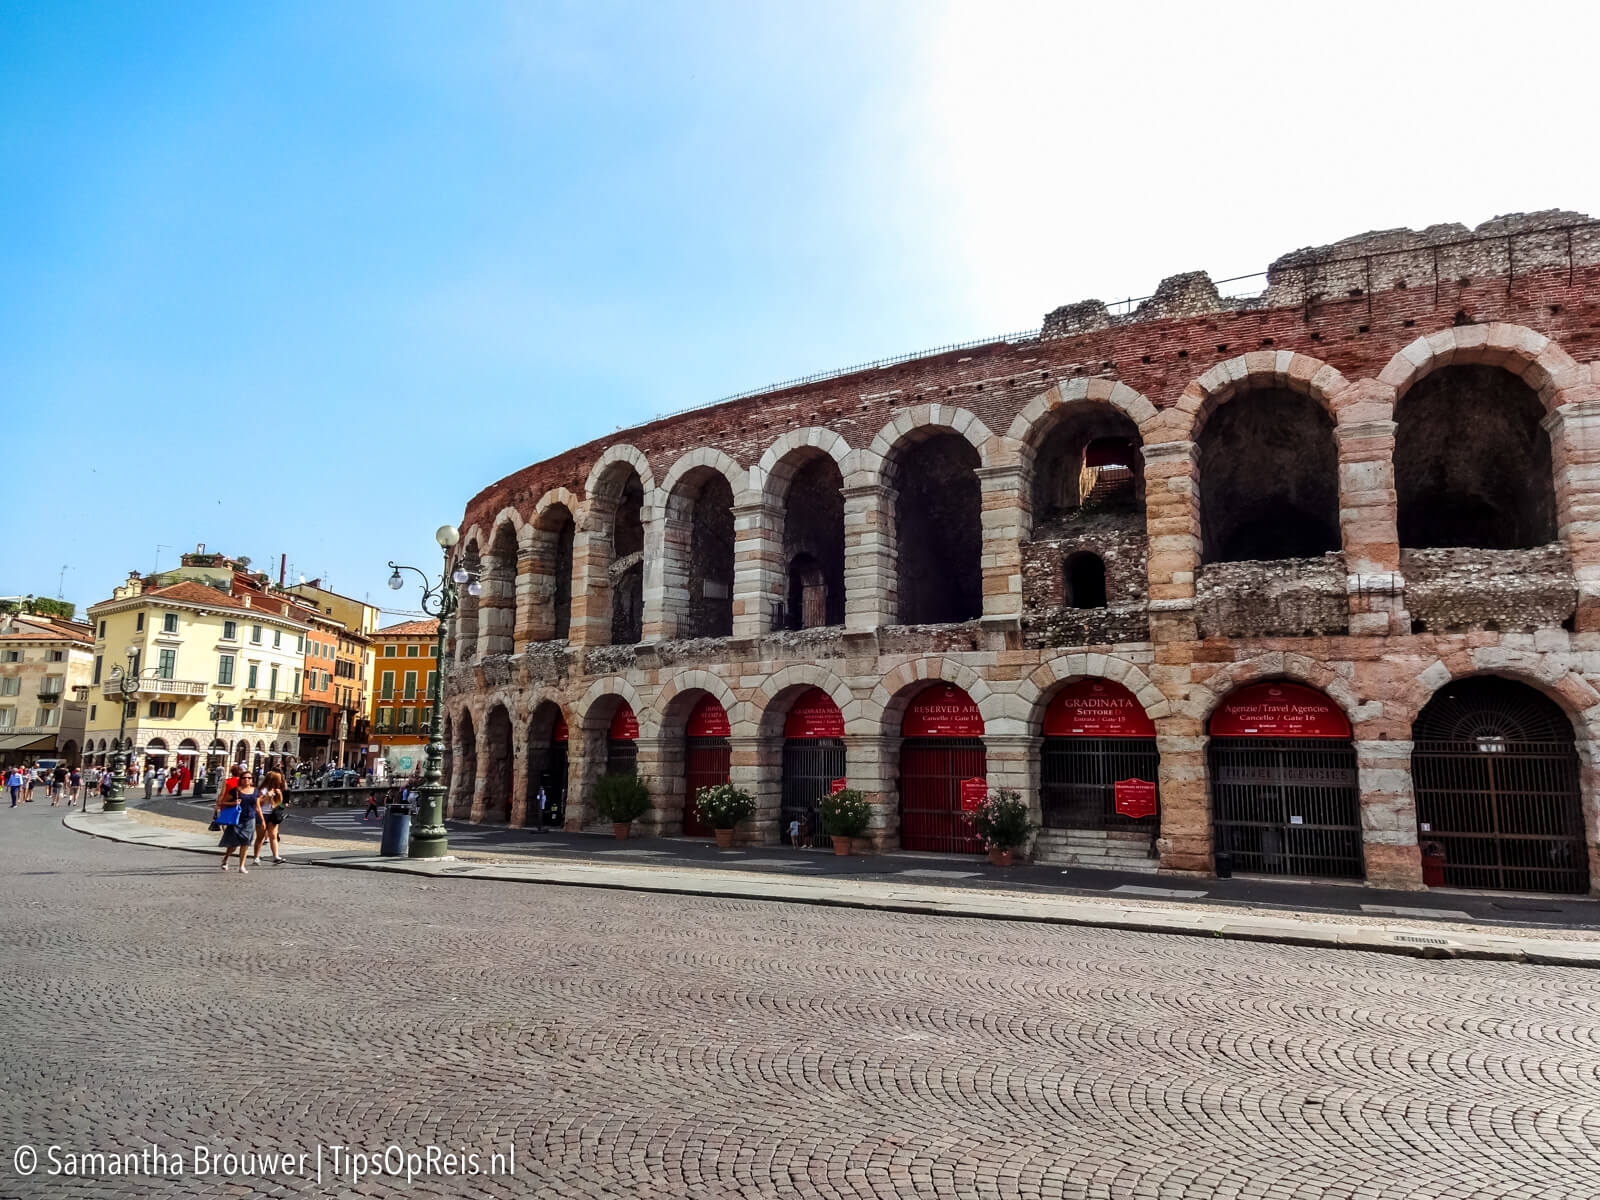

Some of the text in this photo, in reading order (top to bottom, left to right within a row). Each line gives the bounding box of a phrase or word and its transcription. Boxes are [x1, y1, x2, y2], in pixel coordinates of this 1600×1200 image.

[1064, 698, 1134, 708] GRADINATA
[914, 705, 980, 713] RESERVED ARE
[1224, 704, 1329, 715] Agenzie/Travel Agencies
